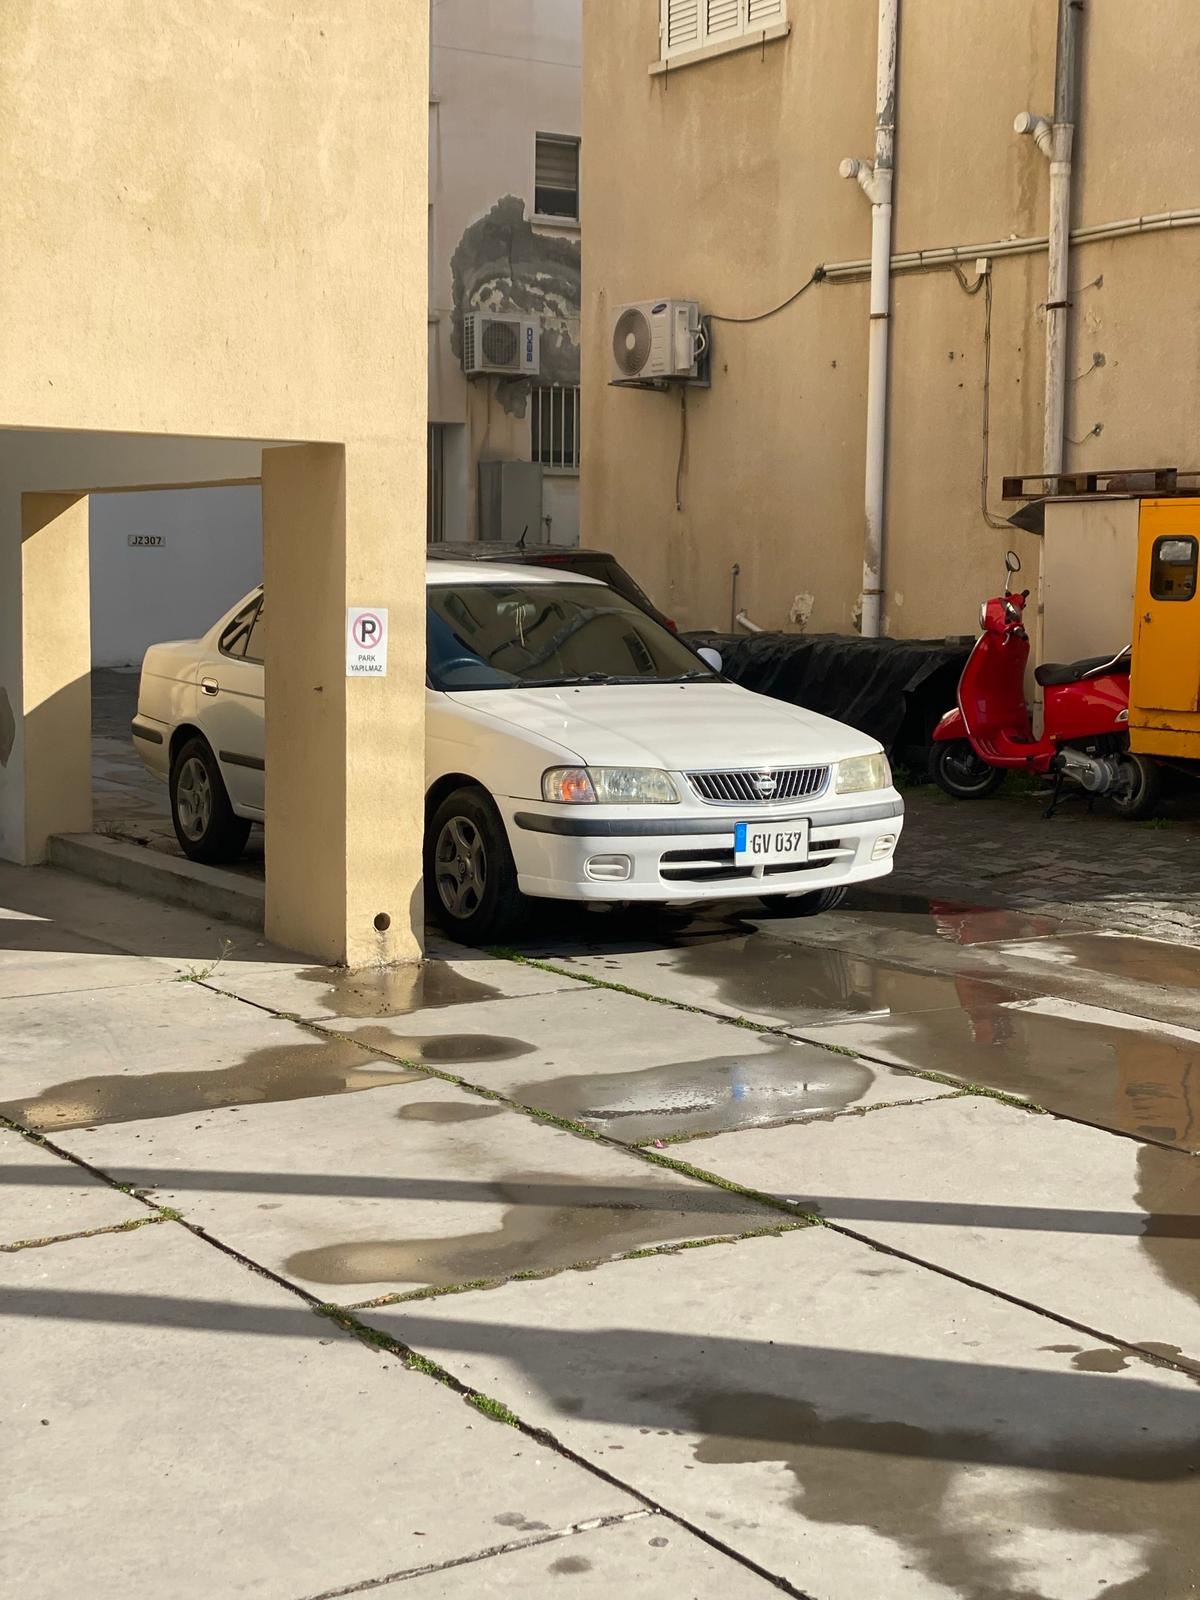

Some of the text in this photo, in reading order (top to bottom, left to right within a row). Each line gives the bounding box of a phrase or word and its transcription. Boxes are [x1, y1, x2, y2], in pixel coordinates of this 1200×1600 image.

[526, 327, 534, 362] BEKO
[361, 619, 377, 643] P
[350, 664, 383, 672] YAPILMAZ
[358, 654, 376, 662] PARK
[752, 831, 802, 854] GV 037
